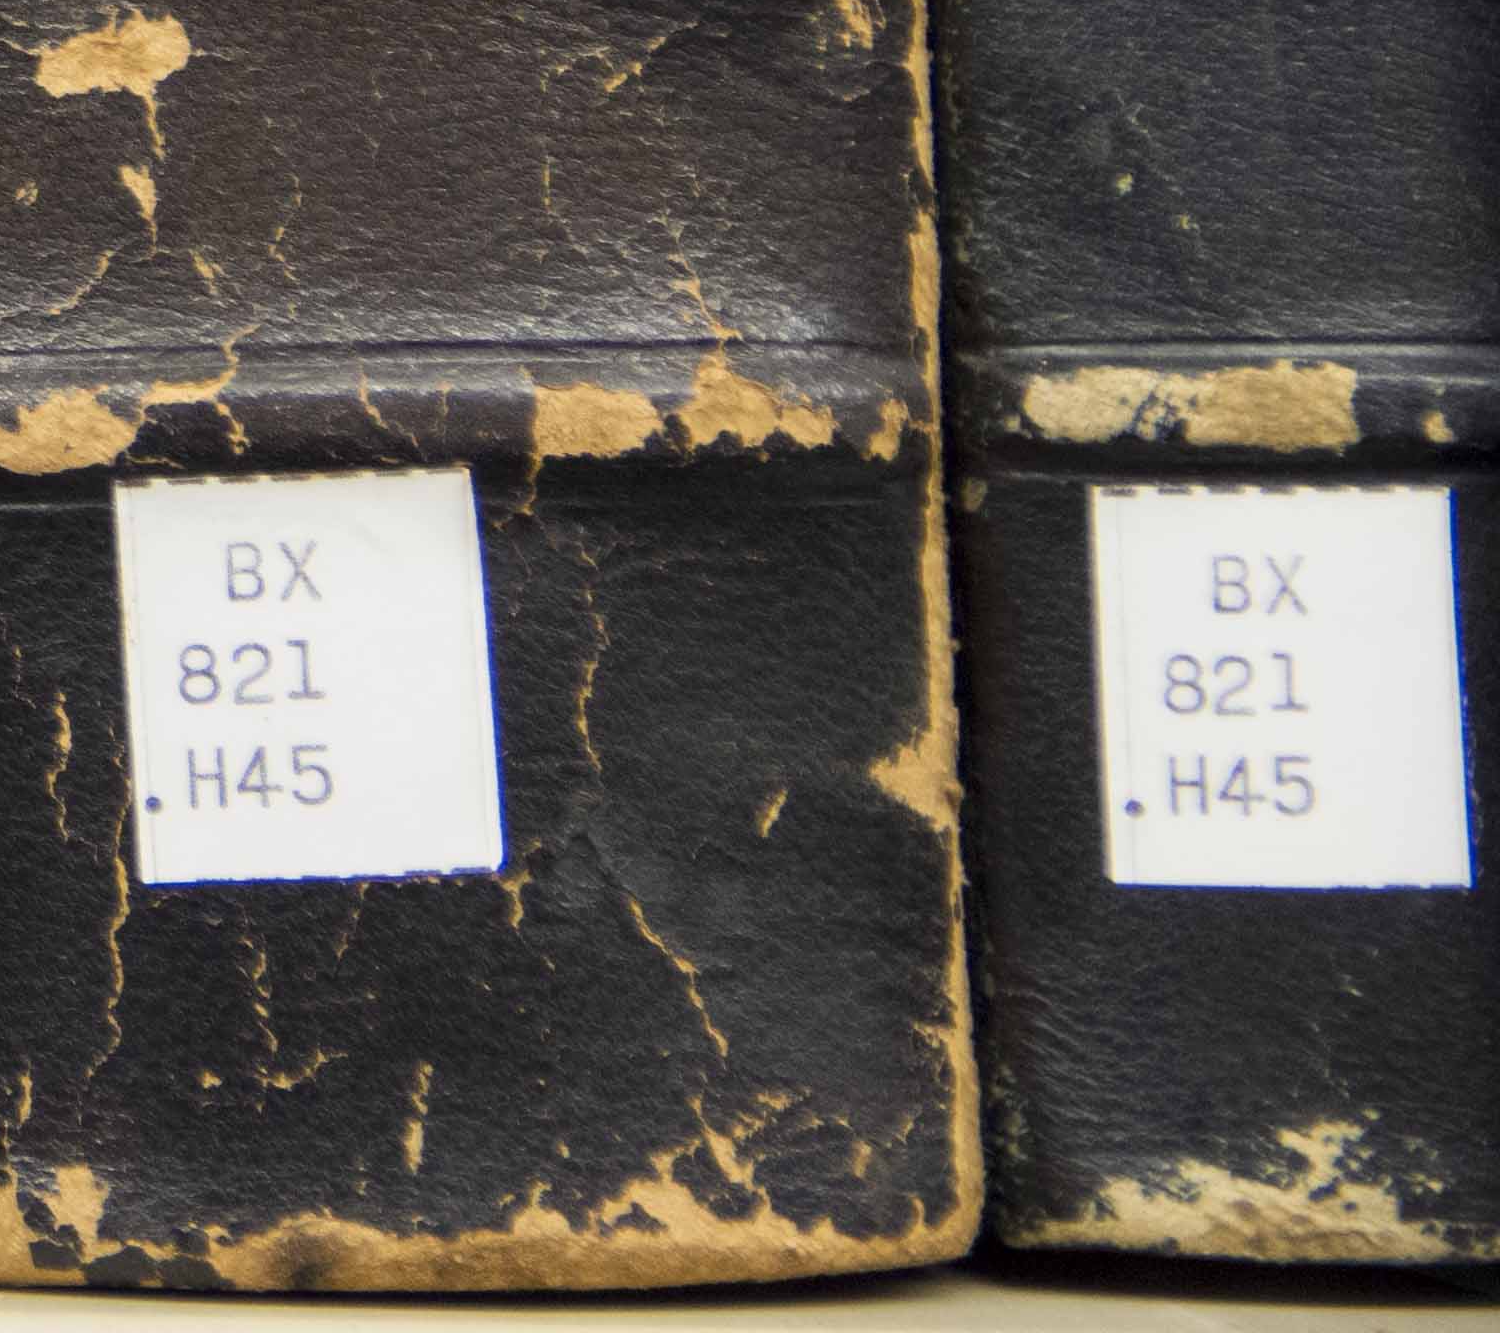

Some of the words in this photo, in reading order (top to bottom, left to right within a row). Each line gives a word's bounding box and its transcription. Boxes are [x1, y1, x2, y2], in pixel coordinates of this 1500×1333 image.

[224, 540, 323, 604] BX
[1210, 552, 1308, 618] BX
[176, 638, 328, 706] 821
[1162, 652, 1311, 719] 821
